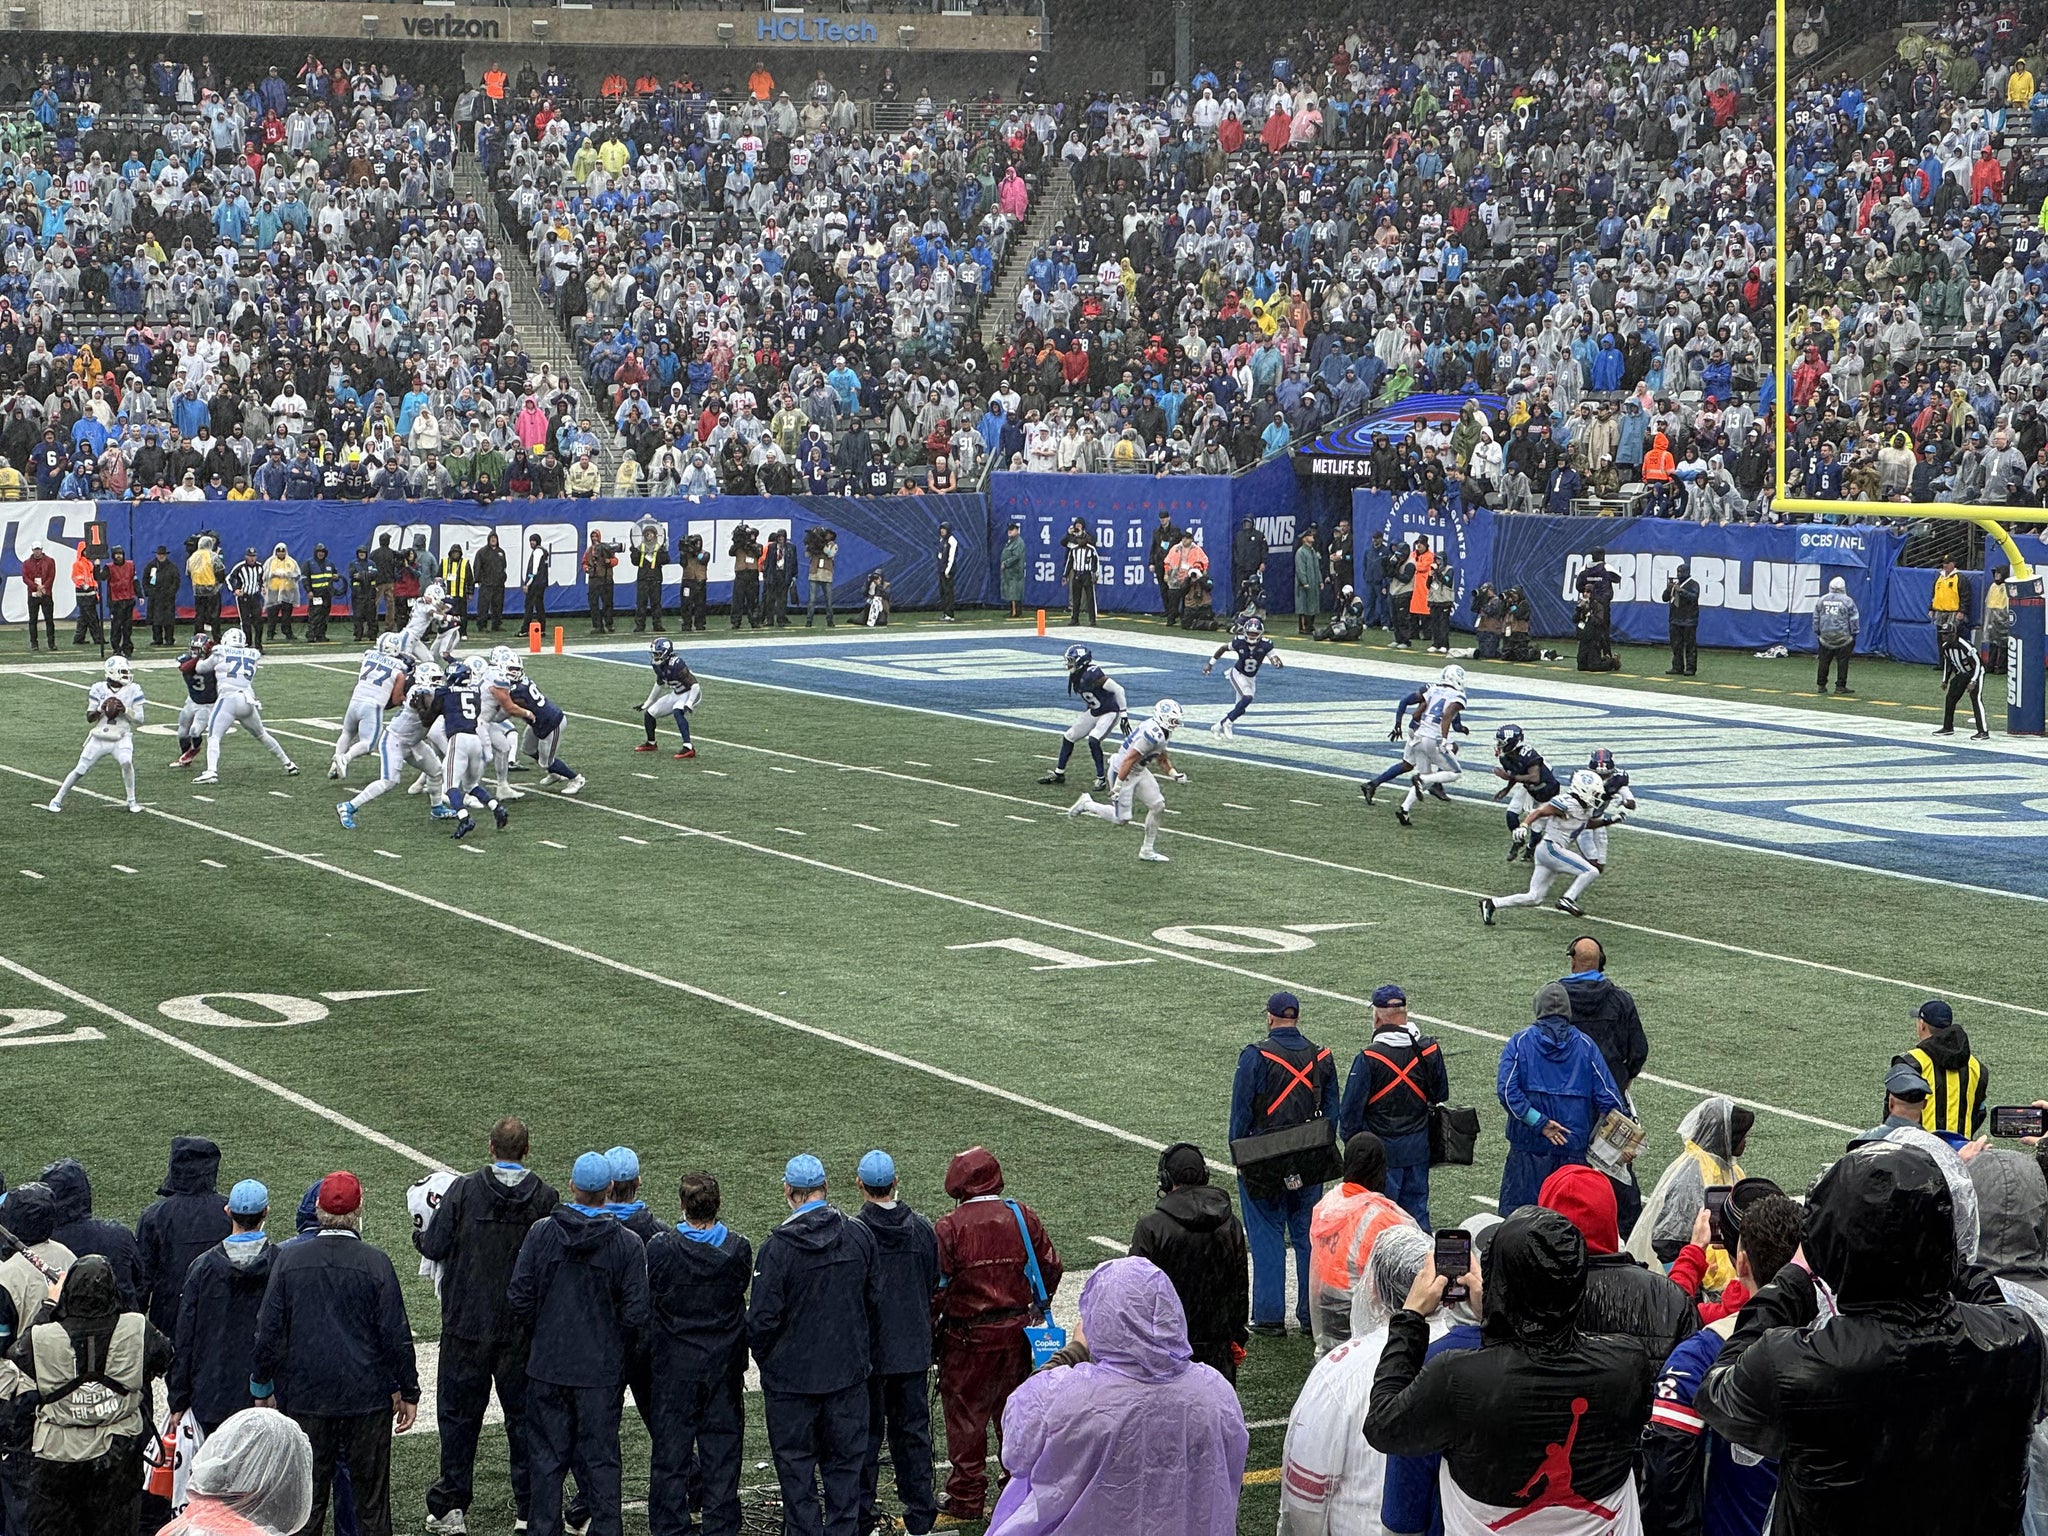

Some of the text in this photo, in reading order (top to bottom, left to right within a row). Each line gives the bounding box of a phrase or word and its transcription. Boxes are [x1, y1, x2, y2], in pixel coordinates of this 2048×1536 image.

[402, 16, 499, 38] verizon
[757, 17, 877, 42] HCLTech
[1405, 71, 1408, 79] 1
[548, 76, 558, 85] 44
[818, 86, 826, 95] 13
[1700, 114, 1703, 124] 1
[1796, 112, 1809, 122] 58
[295, 121, 304, 130] 10
[266, 129, 275, 138] 13
[1182, 131, 1193, 140] 44
[1478, 126, 1484, 136] 6
[794, 156, 805, 164] 92
[374, 164, 385, 173] 52
[75, 181, 86, 191] 10
[1171, 179, 1174, 188] 1
[1299, 192, 1310, 202] 80
[1534, 189, 1544, 199] 44
[1485, 215, 1491, 225] 6
[1607, 224, 1611, 234] 1
[1079, 242, 1088, 251] 13
[1187, 242, 1193, 251] 6
[1661, 243, 1665, 253] 1
[2017, 240, 2027, 251] 10
[18, 253, 24, 262] 5
[1448, 255, 1458, 265] 14
[1825, 258, 1834, 270] 13
[706, 272, 712, 282] 3
[935, 272, 947, 282] 56
[962, 272, 974, 281] 56
[180, 283, 186, 292] 6
[1312, 280, 1325, 293] 77
[1577, 285, 1589, 296] 26
[637, 291, 643, 299] 6
[664, 289, 669, 298] 0
[1294, 311, 1300, 320] 5
[656, 326, 666, 335] 13
[793, 327, 805, 339] 44
[698, 331, 709, 341] 26
[429, 341, 434, 350] 5
[128, 353, 138, 363] ny
[1499, 357, 1511, 367] 89
[136, 400, 140, 411] 1
[783, 418, 794, 428] 13
[1728, 415, 1739, 427] 13
[961, 438, 972, 449] 91
[47, 452, 56, 464] 6
[1312, 458, 1354, 474] METLIFE
[1810, 459, 1816, 473] 5
[1991, 459, 1997, 475] 1
[324, 472, 338, 486] 26
[872, 473, 885, 486] 68
[1553, 472, 1561, 491] 1
[1822, 475, 1829, 488] 6
[845, 486, 850, 494] 6
[1403, 514, 1446, 527] SINCE
[91, 525, 100, 545] 1
[1041, 525, 1050, 544] 4
[1096, 527, 1114, 547] 10
[1128, 528, 1143, 548] 11
[1035, 562, 1055, 581] 32
[1124, 565, 1145, 585] 50
[1691, 556, 1820, 613] BLUE
[226, 656, 256, 681] 75
[1244, 658, 1258, 673] 8
[360, 660, 393, 687] 77
[192, 674, 206, 691] 3
[460, 692, 476, 720] 5
[1034, 1339, 1061, 1349] Copilot
[72, 1387, 116, 1404] MEDIA
